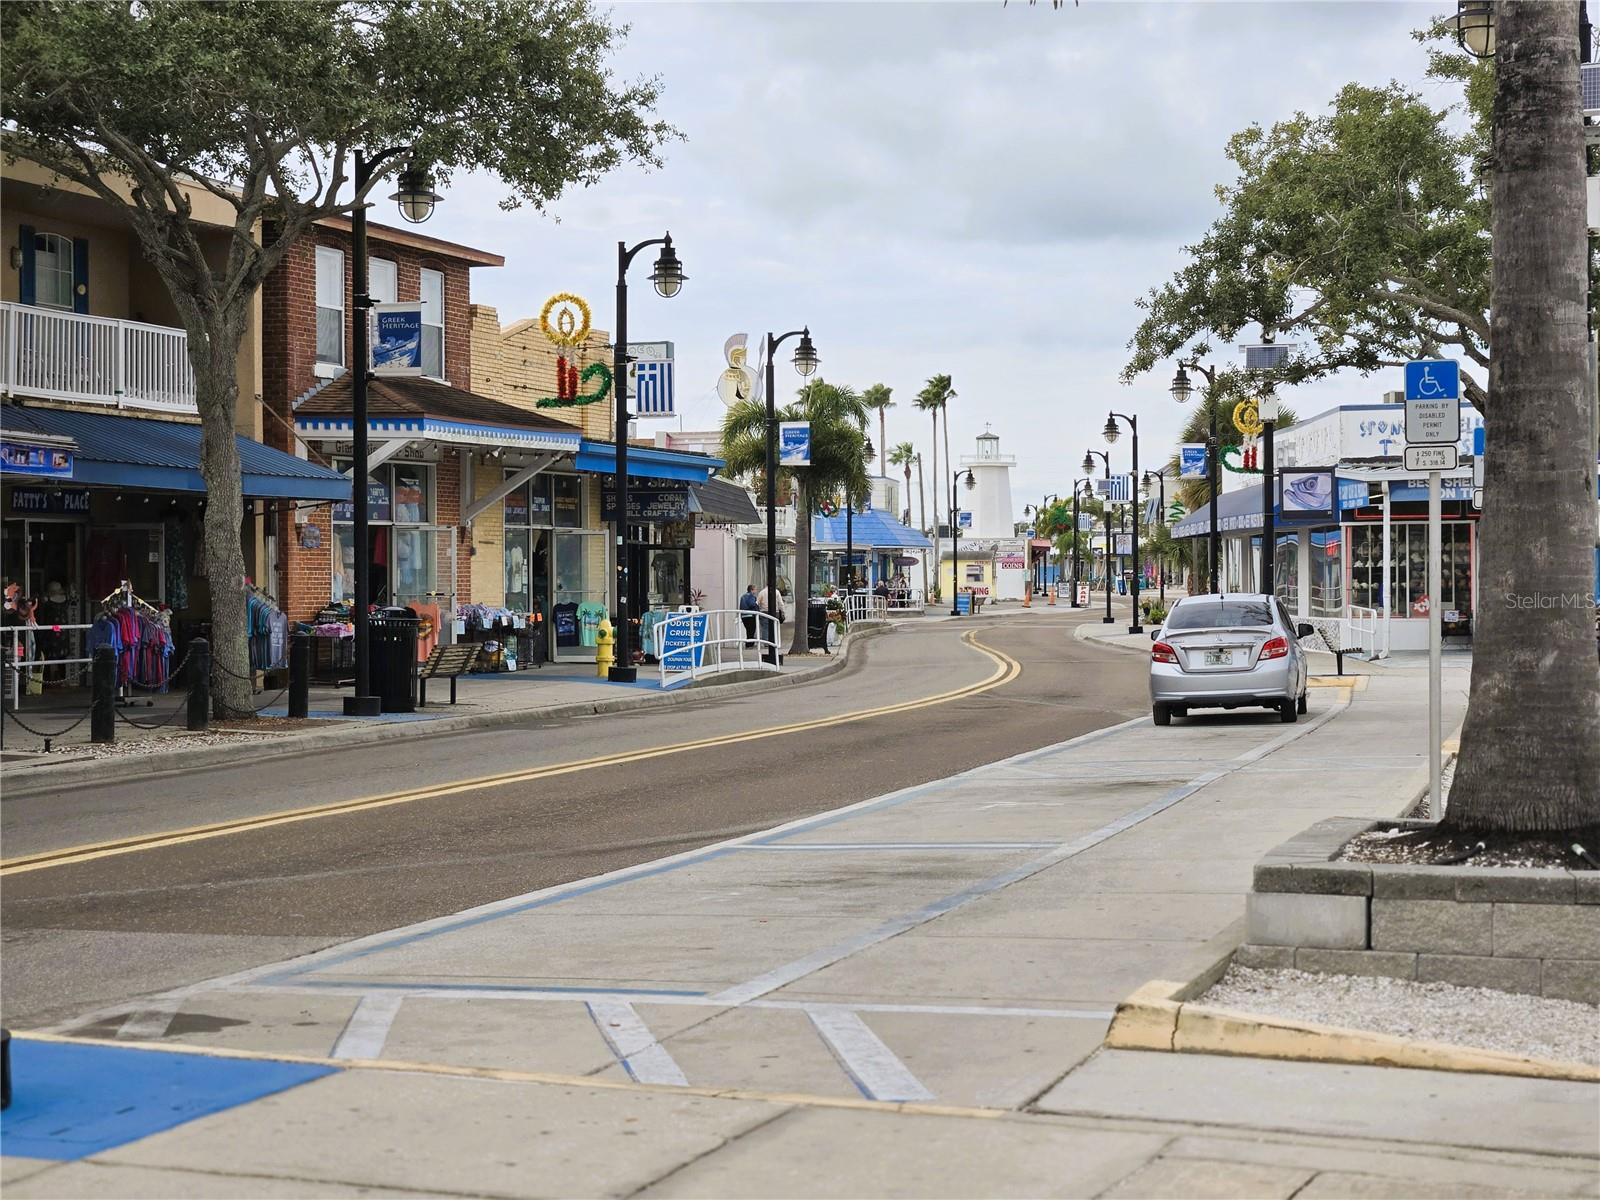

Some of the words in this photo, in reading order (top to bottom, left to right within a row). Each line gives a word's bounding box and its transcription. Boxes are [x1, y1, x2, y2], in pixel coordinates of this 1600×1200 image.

[1407, 479, 1430, 488] BES
[12, 491, 48, 509] FATTY'S
[64, 494, 89, 510] PLACE
[657, 494, 683, 502] CORAL
[647, 501, 685, 511] JEWELRY
